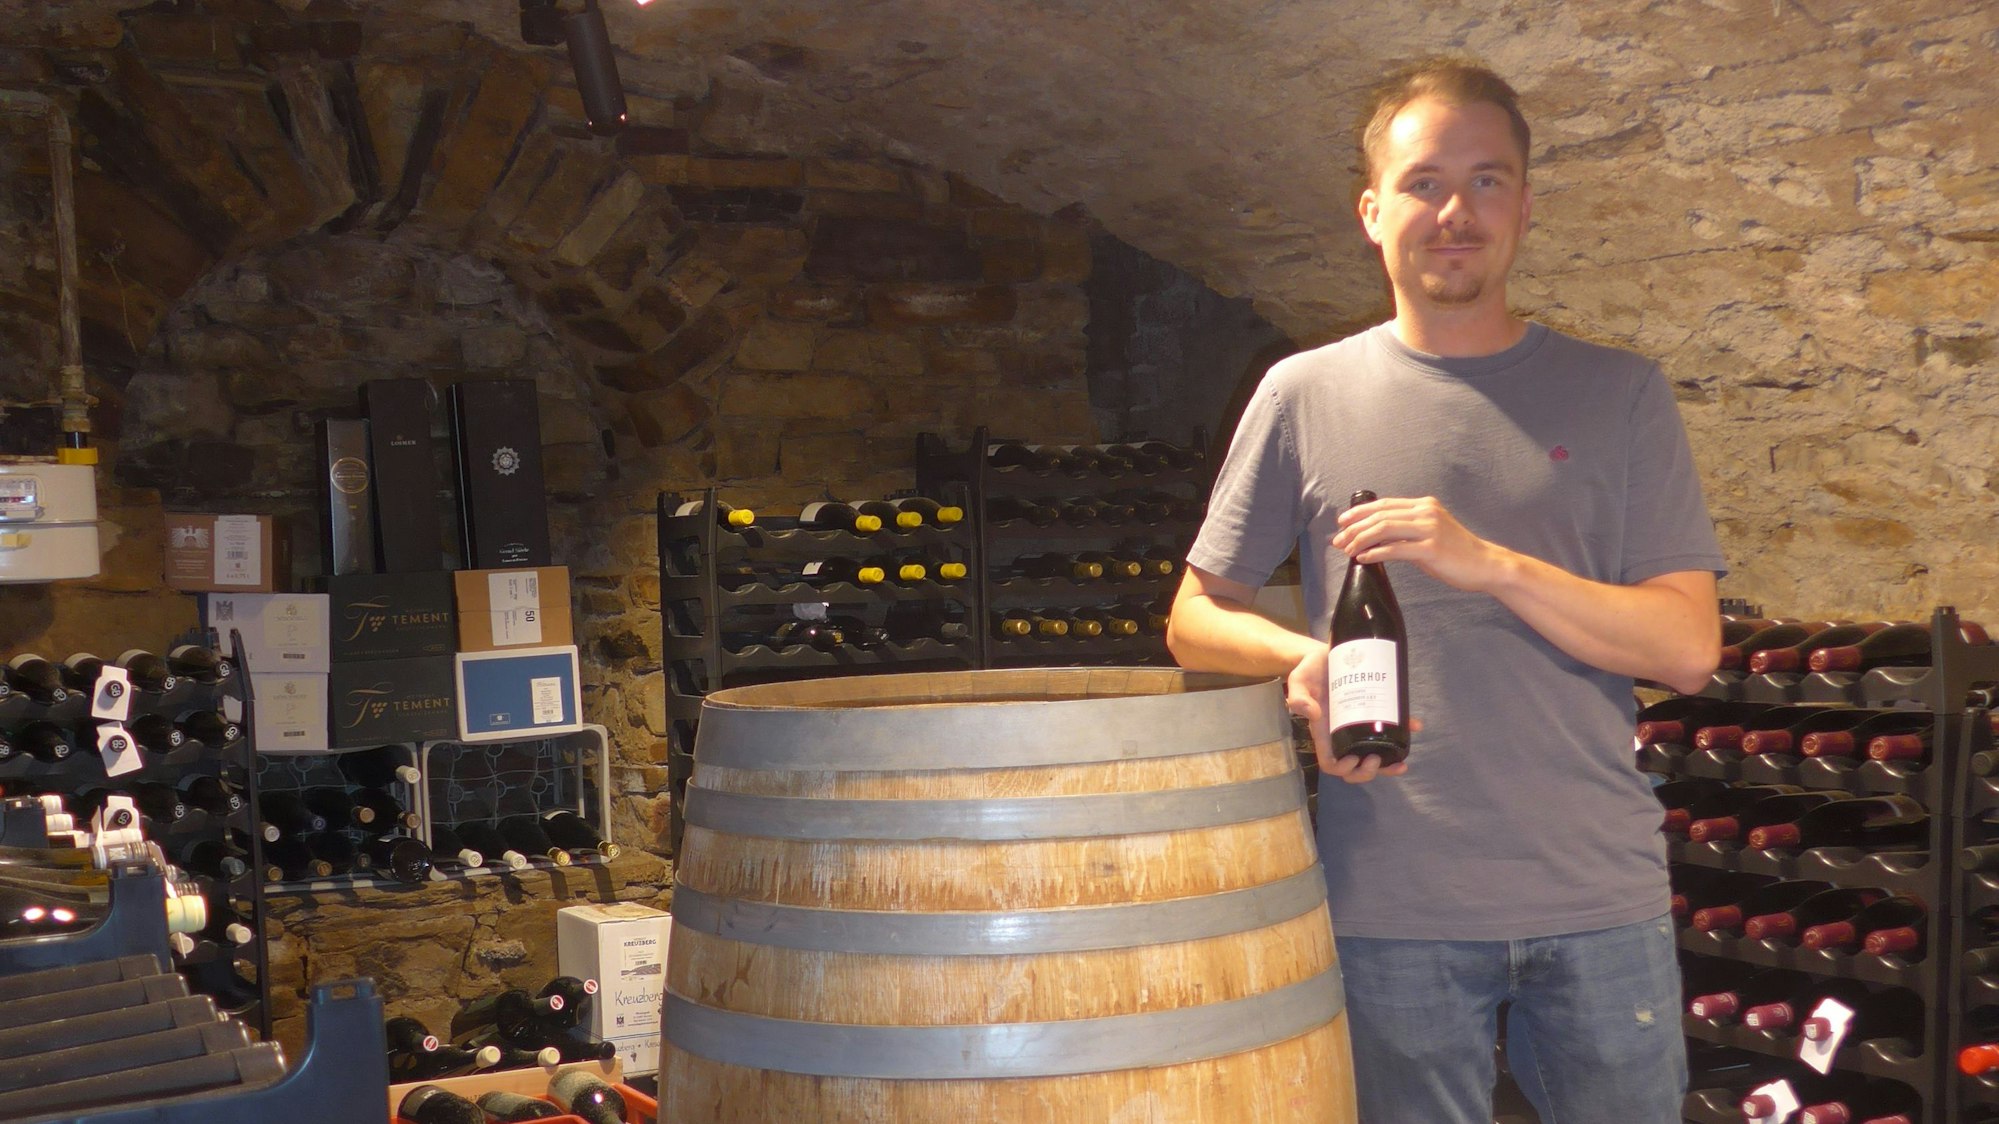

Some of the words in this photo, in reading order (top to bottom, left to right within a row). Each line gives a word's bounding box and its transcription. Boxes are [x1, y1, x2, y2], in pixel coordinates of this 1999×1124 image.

[392, 612, 449, 625] TEMENT
[525, 610, 535, 622] 50
[393, 697, 450, 711] TEMENT
[624, 939, 657, 947] KREUZBERG
